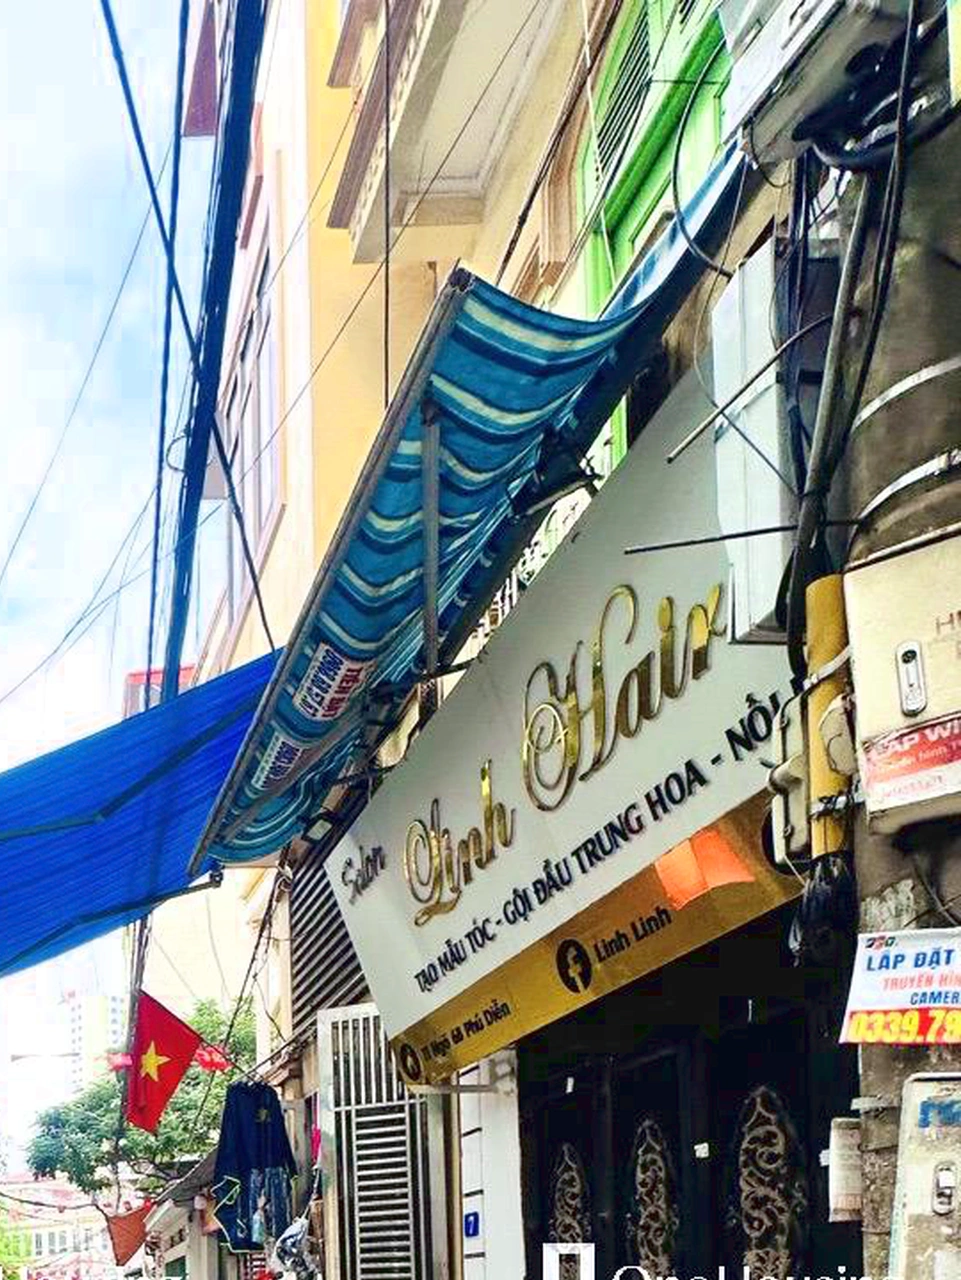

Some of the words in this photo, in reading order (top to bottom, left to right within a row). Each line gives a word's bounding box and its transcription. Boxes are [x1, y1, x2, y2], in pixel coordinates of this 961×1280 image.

[523, 582, 728, 812] Hair
[404, 758, 517, 928] Linh
[414, 963, 440, 993] TẠO
[465, 917, 498, 954] TÓC
[502, 886, 535, 926] GỘI
[571, 801, 644, 876] TRUNG
[643, 757, 710, 823] HOA
[463, 1013, 485, 1038] Phú
[482, 998, 511, 1027] Diễn
[593, 929, 631, 963] Linh
[630, 905, 673, 942] Linh
